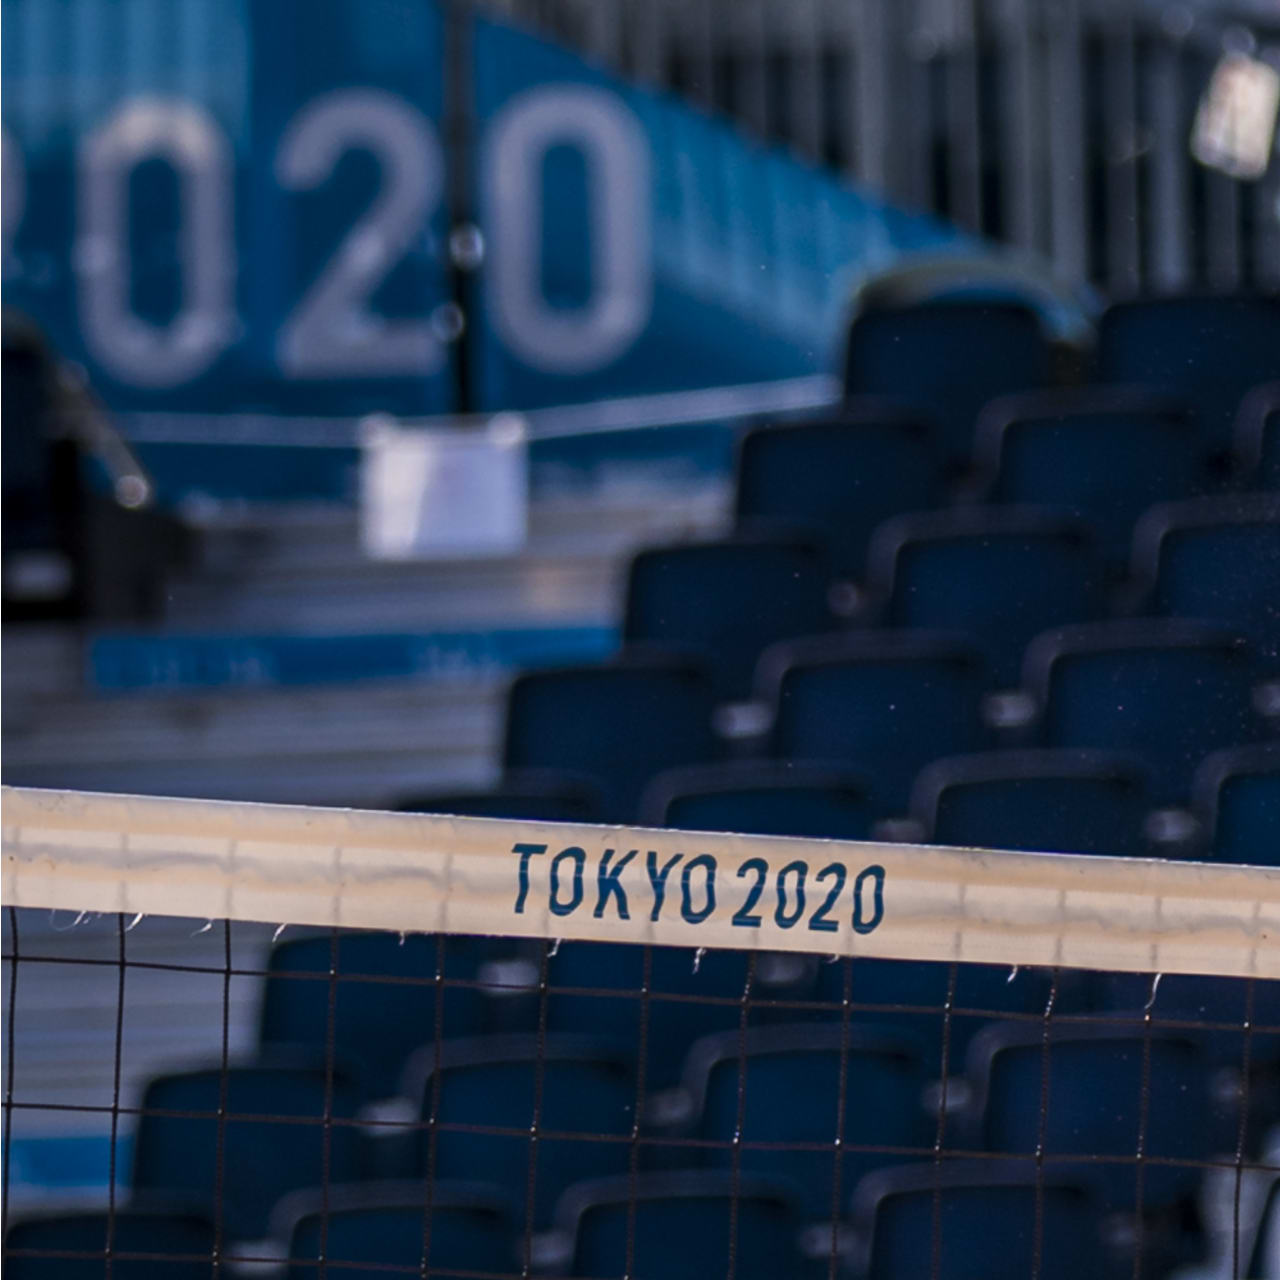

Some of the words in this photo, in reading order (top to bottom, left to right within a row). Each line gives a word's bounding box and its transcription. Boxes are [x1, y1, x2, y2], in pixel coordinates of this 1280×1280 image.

[0, 83, 653, 389] 020
[511, 843, 718, 924] TOKYO
[731, 857, 886, 935] 2020
